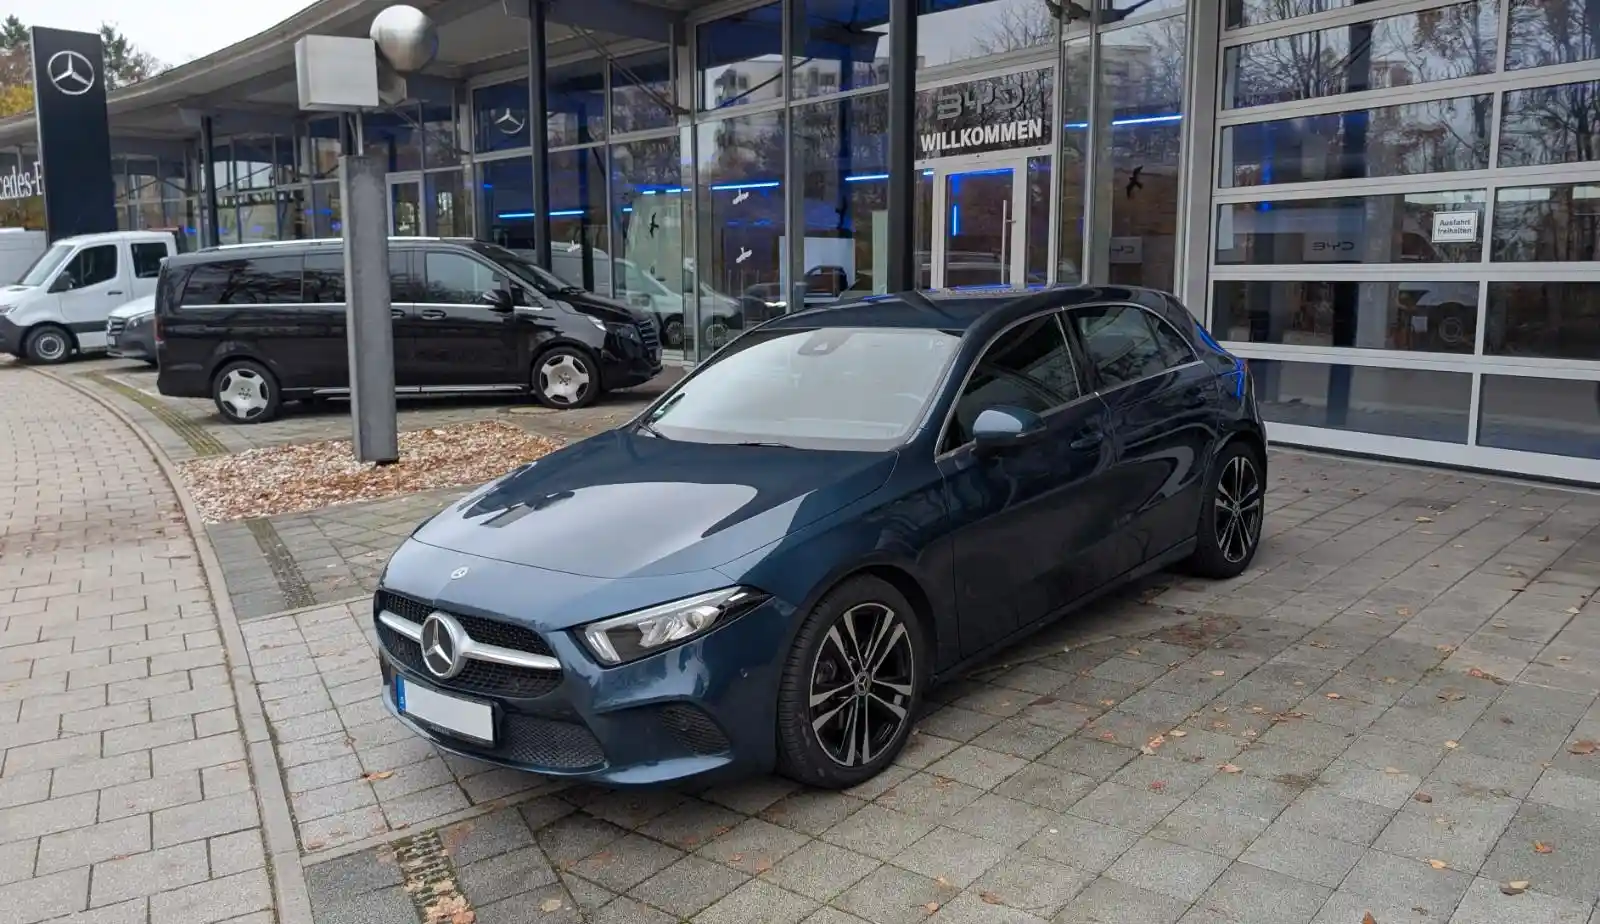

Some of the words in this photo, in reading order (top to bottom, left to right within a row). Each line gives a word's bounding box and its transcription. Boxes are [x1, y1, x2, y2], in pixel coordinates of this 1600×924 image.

[936, 80, 1022, 120] BYD
[920, 118, 1042, 152] WILLKOMMEN
[1439, 218, 1471, 226] Ausfahrt
[1437, 227, 1473, 235] freihalten
[1312, 240, 1355, 251] BYD
